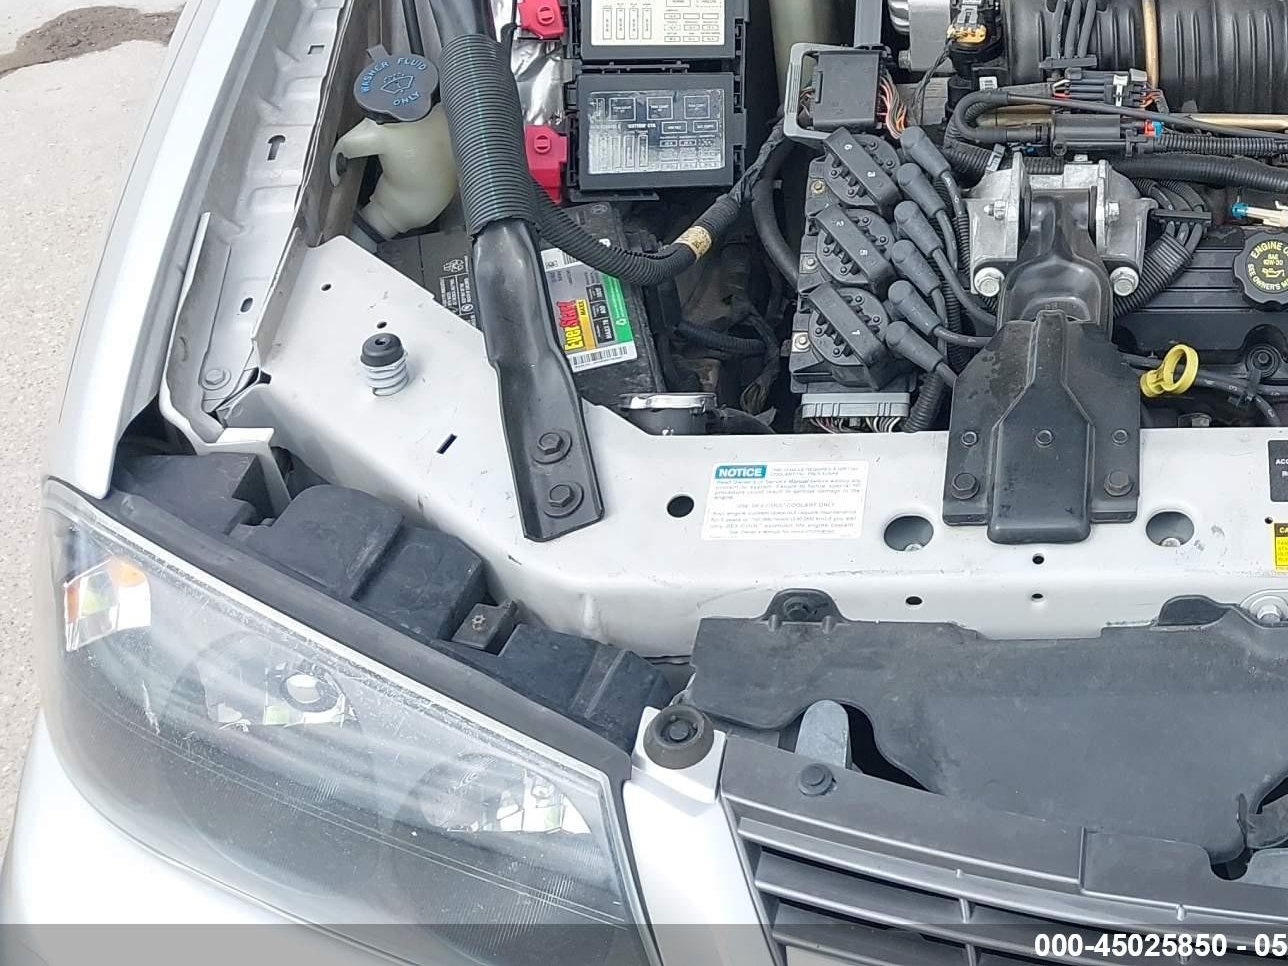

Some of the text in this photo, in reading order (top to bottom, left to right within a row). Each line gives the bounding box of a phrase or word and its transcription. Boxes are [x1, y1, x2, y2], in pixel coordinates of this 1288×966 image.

[360, 57, 428, 93] WASHER FLUID
[392, 90, 421, 106] ONLY
[1250, 240, 1283, 260] ENGINE
[1247, 263, 1256, 278] SEE
[1252, 275, 1281, 291] OWNER'S
[577, 299, 588, 316] MAXX
[718, 467, 763, 478] NOTICE
